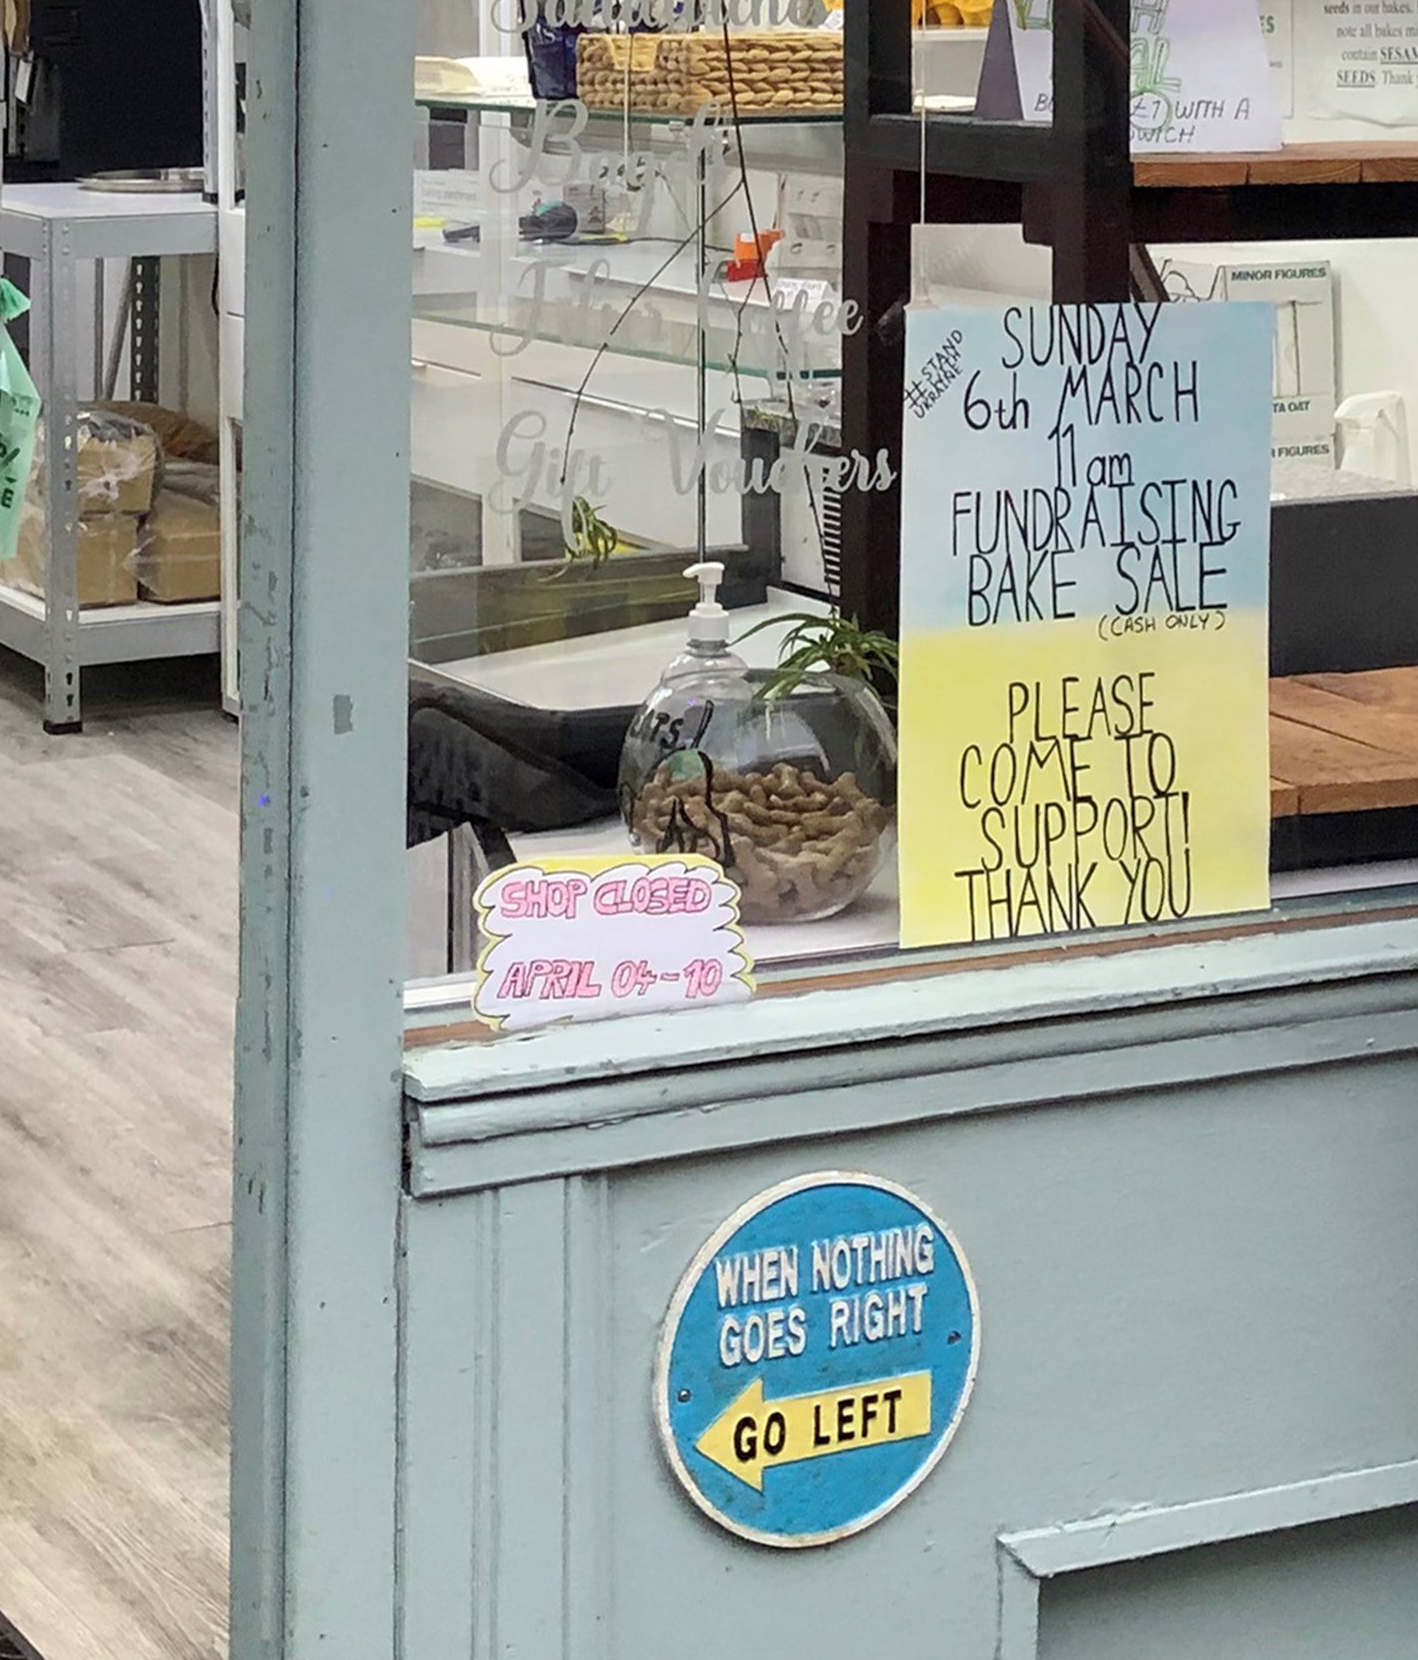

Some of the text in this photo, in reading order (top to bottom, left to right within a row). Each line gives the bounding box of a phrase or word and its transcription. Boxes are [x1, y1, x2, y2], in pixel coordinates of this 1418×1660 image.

[1324, 1, 1350, 15] seeds
[1353, 2, 1362, 14] in
[1364, 4, 1379, 14] our
[1336, 25, 1357, 38] note
[1359, 23, 1372, 38] all
[1375, 23, 1402, 38] bakes
[1341, 48, 1378, 61] contain
[1381, 70, 1413, 85] Thank
[1175, 99, 1225, 119] WITH
[1234, 97, 1251, 120] A
[1231, 267, 1326, 282] MINOR FIGURES
[1002, 302, 1161, 369] SUNDAY
[913, 366, 963, 419] UKRAINE
[963, 360, 1199, 431] 6th MARCH
[1288, 401, 1310, 412] OAT
[641, 407, 898, 496] Vouchers
[1278, 444, 1330, 457] FIGURES
[953, 478, 1242, 557] FUNDRAISING
[969, 542, 1228, 627] BAKE SALE
[1098, 609, 1227, 641] (CASH ONLY)
[1008, 672, 1156, 744] PLEASE
[959, 731, 1177, 810] COME TO
[981, 790, 1191, 873] SUPPORT!
[500, 876, 713, 919] SHOP CLOSED
[954, 846, 1191, 941] THANK YOU
[496, 959, 602, 1000] APRIL
[715, 1221, 935, 1309] WHEN NOTHING
[719, 1283, 929, 1369] GOES RIGHT
[733, 1389, 903, 1463] GO LEFT
